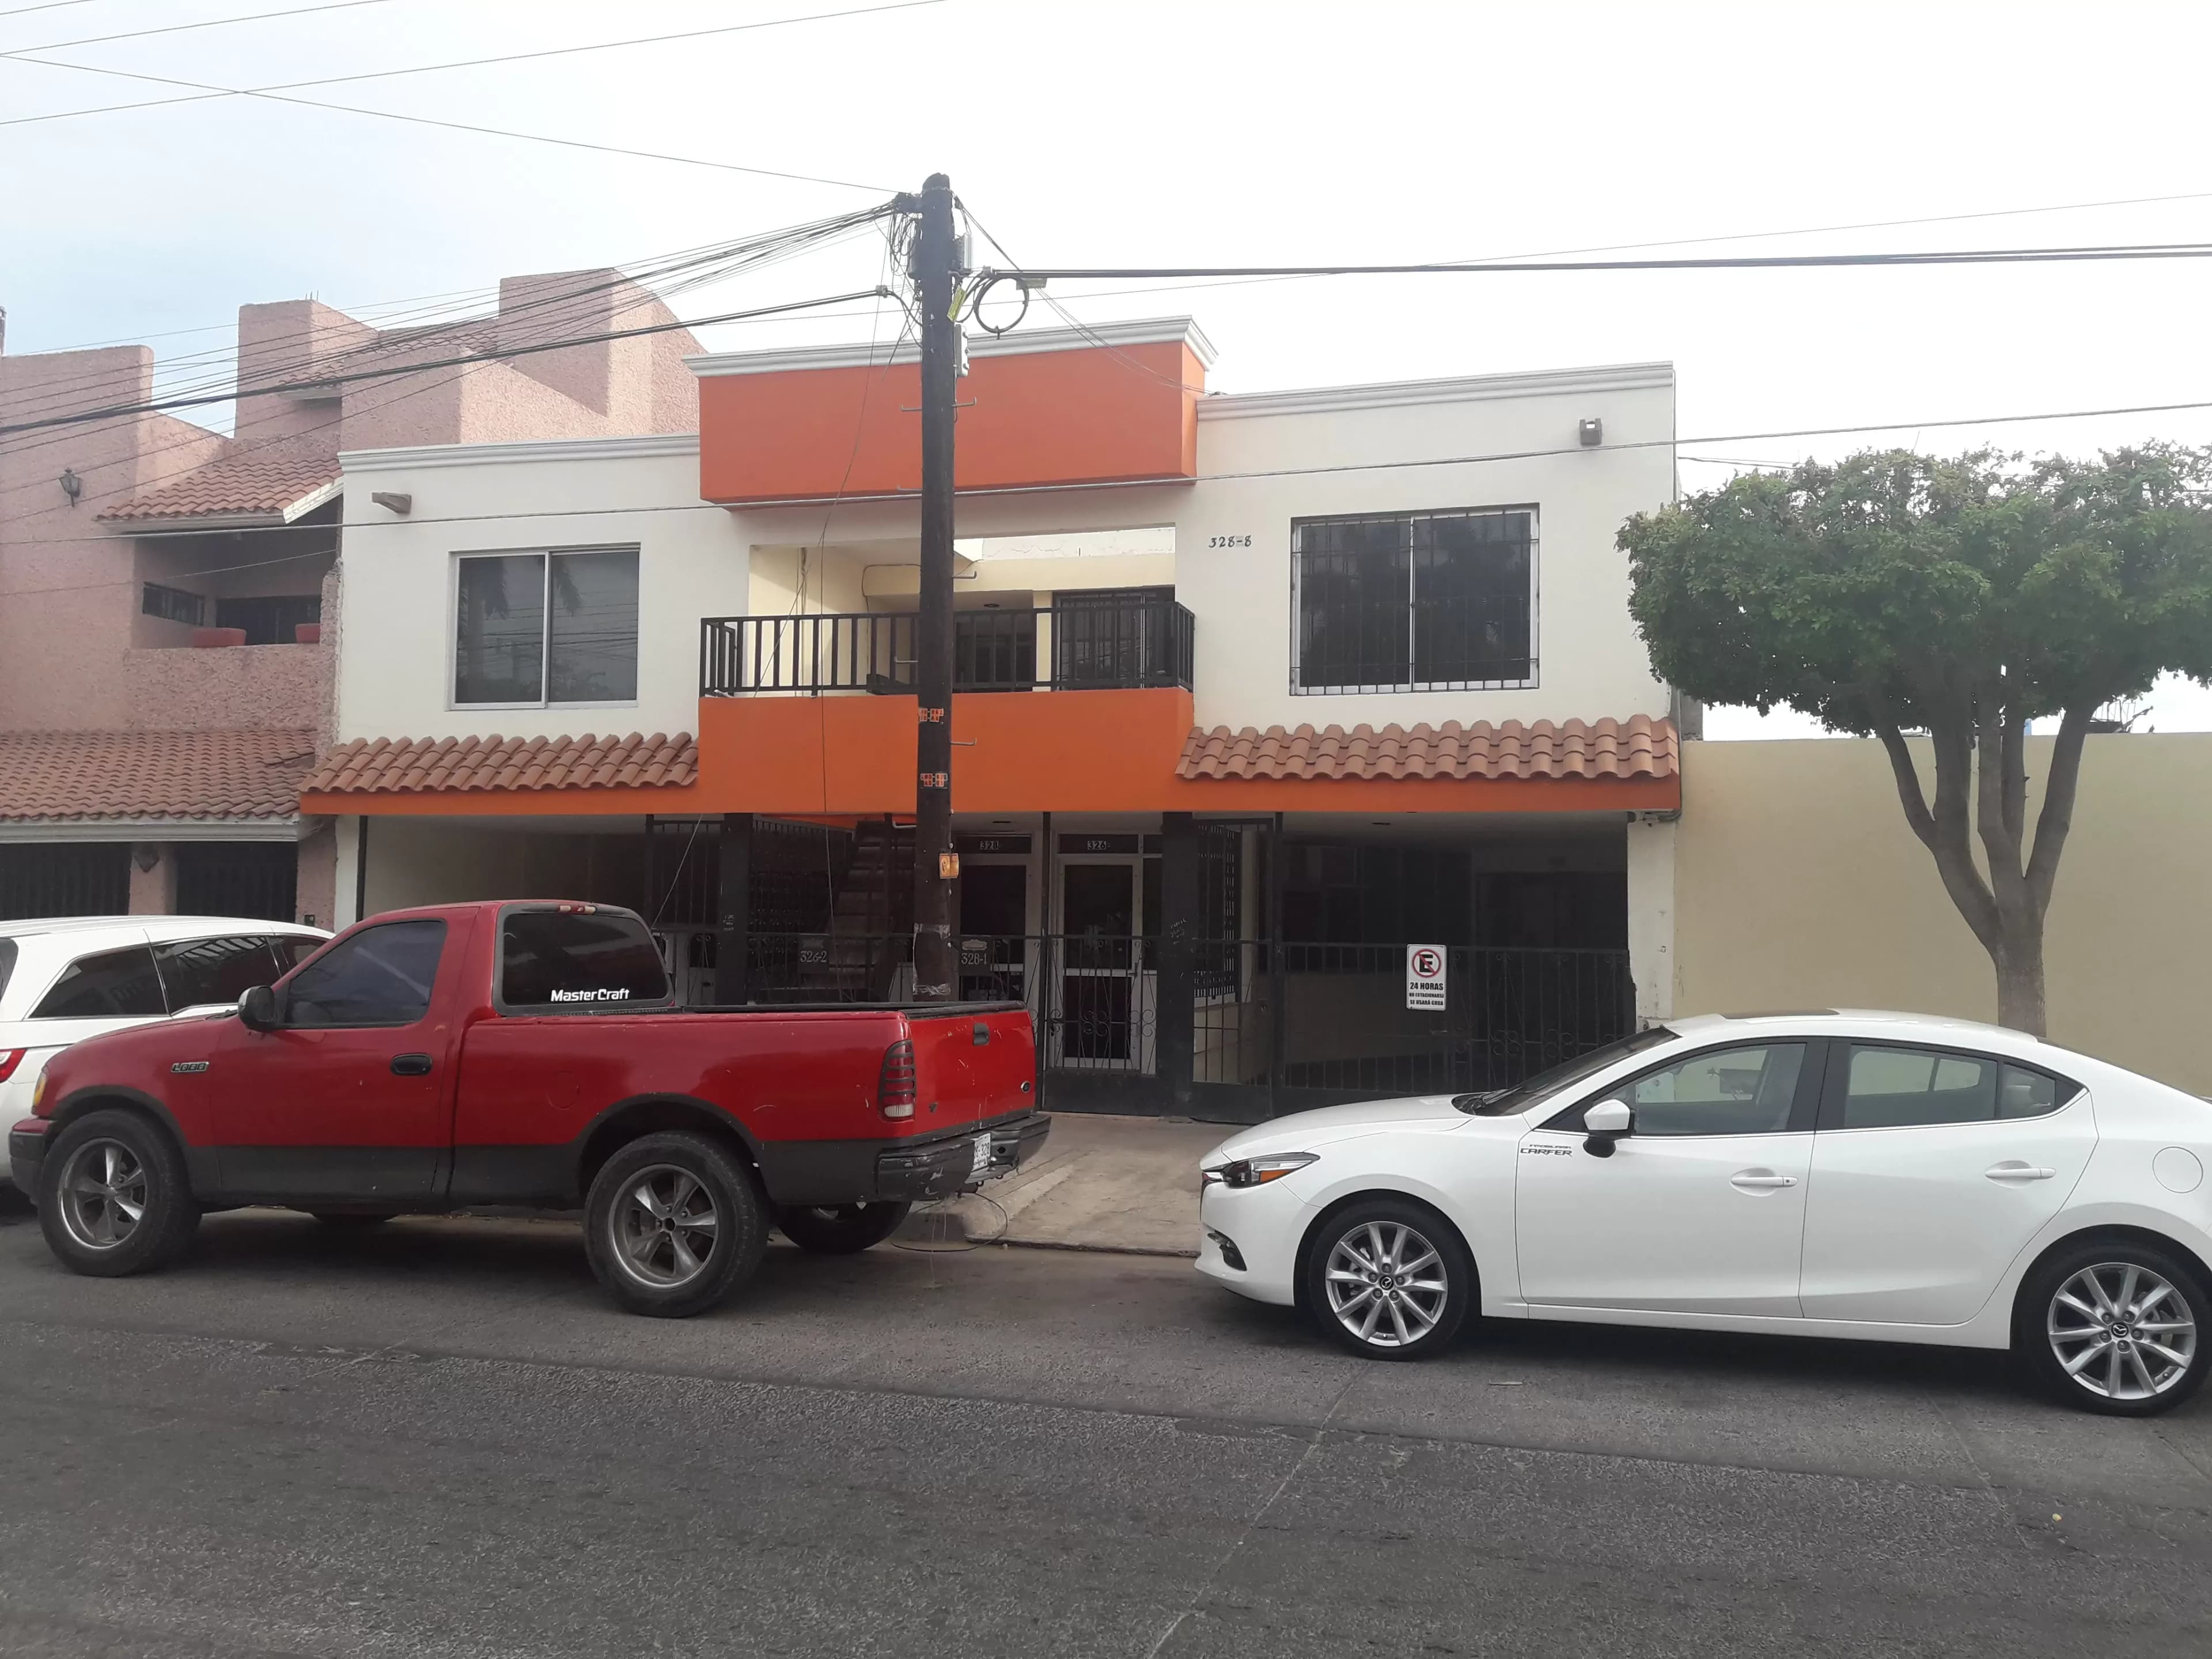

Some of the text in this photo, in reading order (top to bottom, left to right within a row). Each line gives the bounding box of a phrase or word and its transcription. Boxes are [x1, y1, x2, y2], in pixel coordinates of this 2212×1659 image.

[1208, 534, 1252, 548] 328-8
[1410, 982, 1444, 990] 24 HORAS
[1520, 1148, 1573, 1157] CARFER
